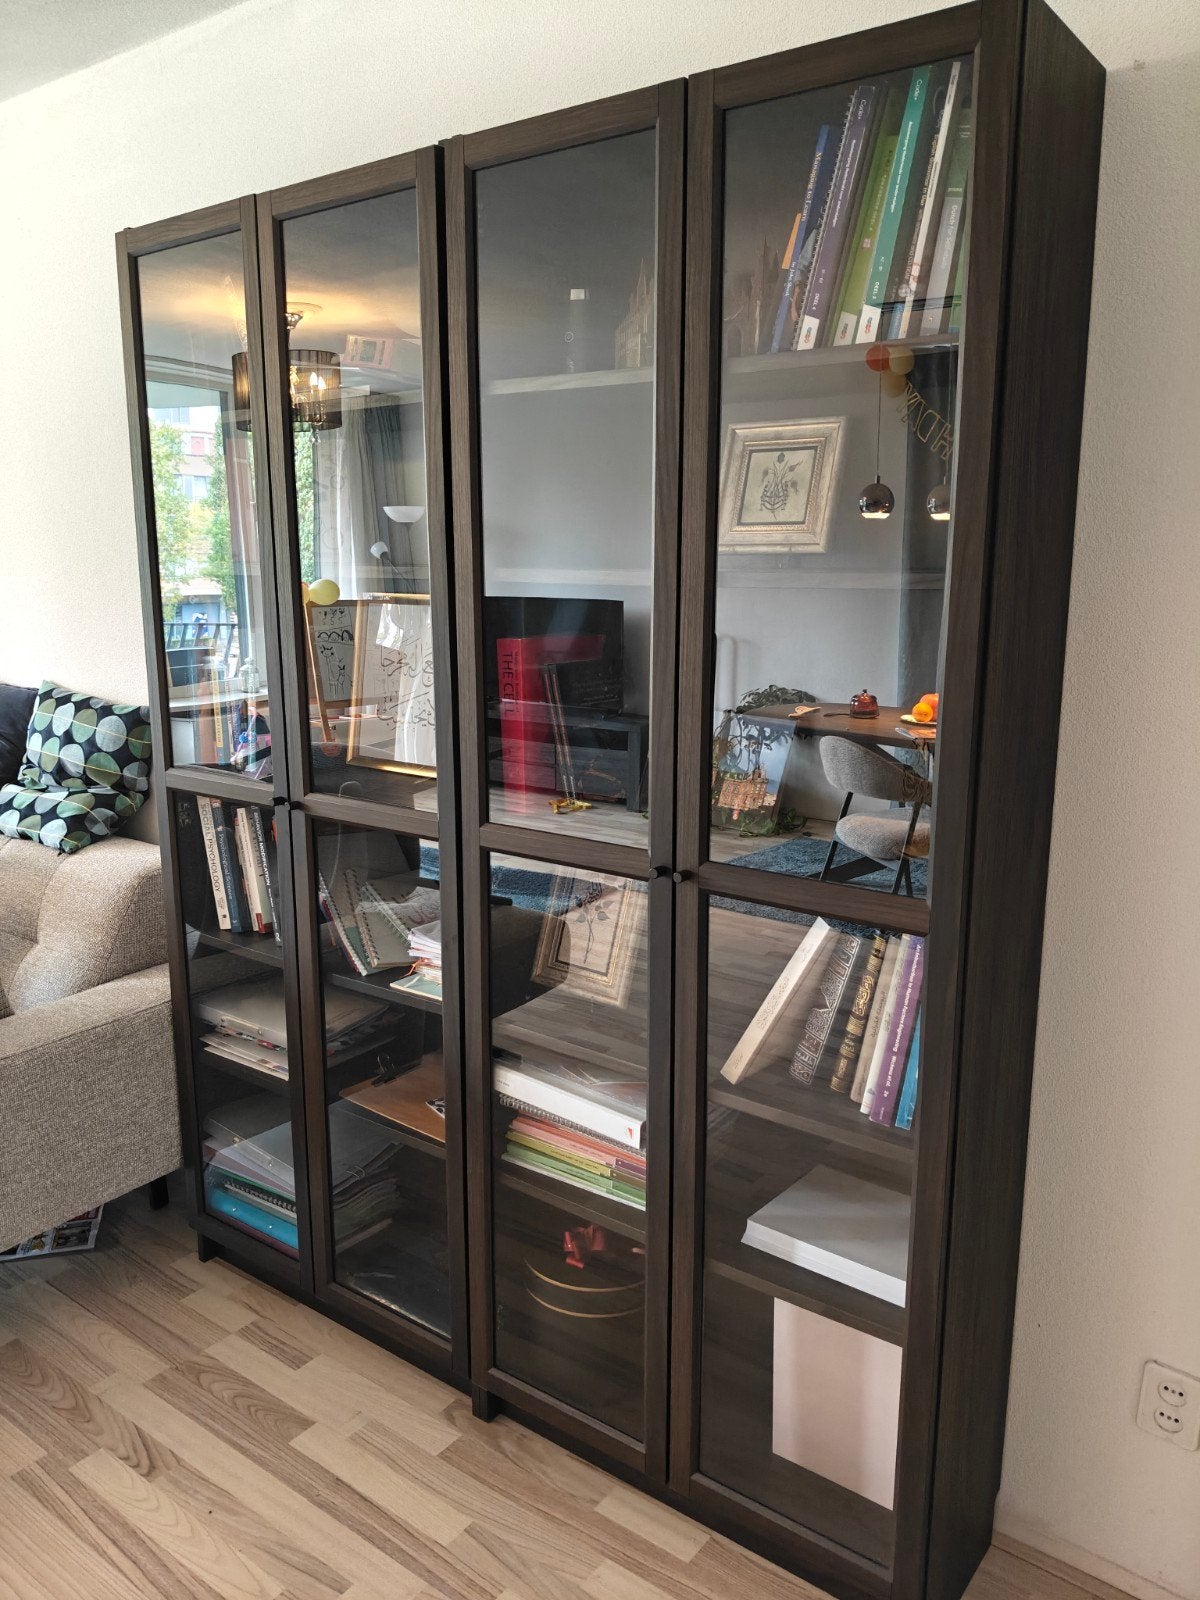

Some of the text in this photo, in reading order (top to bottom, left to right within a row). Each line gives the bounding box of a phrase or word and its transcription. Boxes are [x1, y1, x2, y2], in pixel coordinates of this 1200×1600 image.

[929, 134, 939, 156] English
[800, 151, 822, 221] Managing to Learn
[923, 156, 934, 186] Grammar
[787, 268, 795, 281] John
[501, 651, 516, 716] THE CELL
[200, 803, 221, 893] SOCIAL PSYCHOLOGY
[253, 811, 262, 841] BEHAVIOR
[258, 842, 270, 885] MODIFICATION
[218, 833, 233, 899] Psychological Science
[908, 952, 920, 982] Introduction
[903, 987, 912, 1005] Human
[898, 1005, 908, 1023] Factors
[892, 1023, 904, 1052] Engineering
[887, 1055, 896, 1075] Wickens
